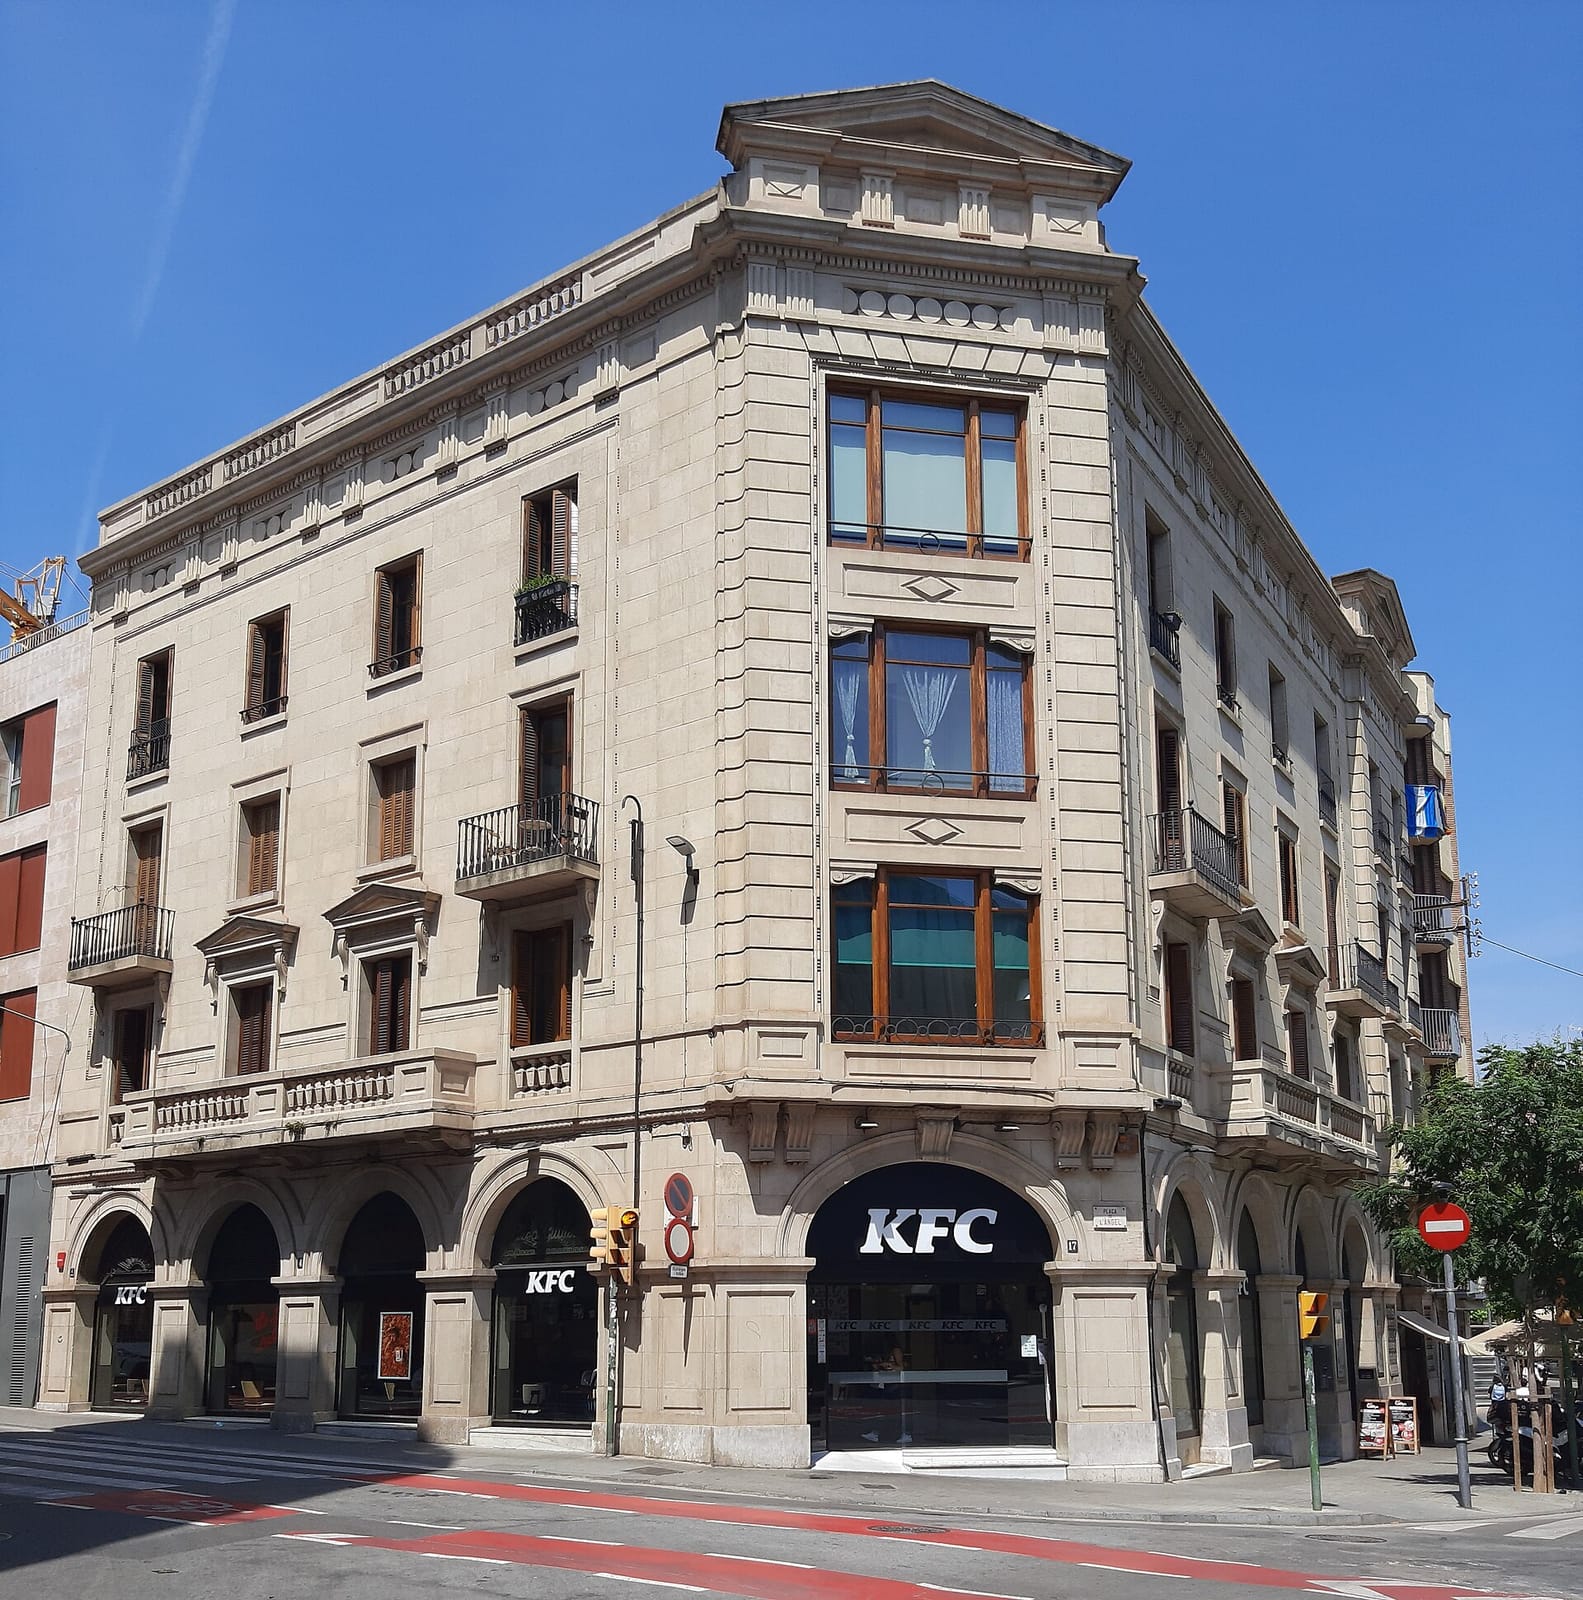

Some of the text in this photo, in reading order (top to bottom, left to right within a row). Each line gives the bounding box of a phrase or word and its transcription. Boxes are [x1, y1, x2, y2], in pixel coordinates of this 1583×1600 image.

[860, 1208, 998, 1254] KFC
[1069, 1241, 1077, 1251] 17
[525, 1270, 575, 1294] KFC
[114, 1286, 148, 1305] KFC
[835, 1320, 997, 1330] KFC KFC KFC KFC KFC
